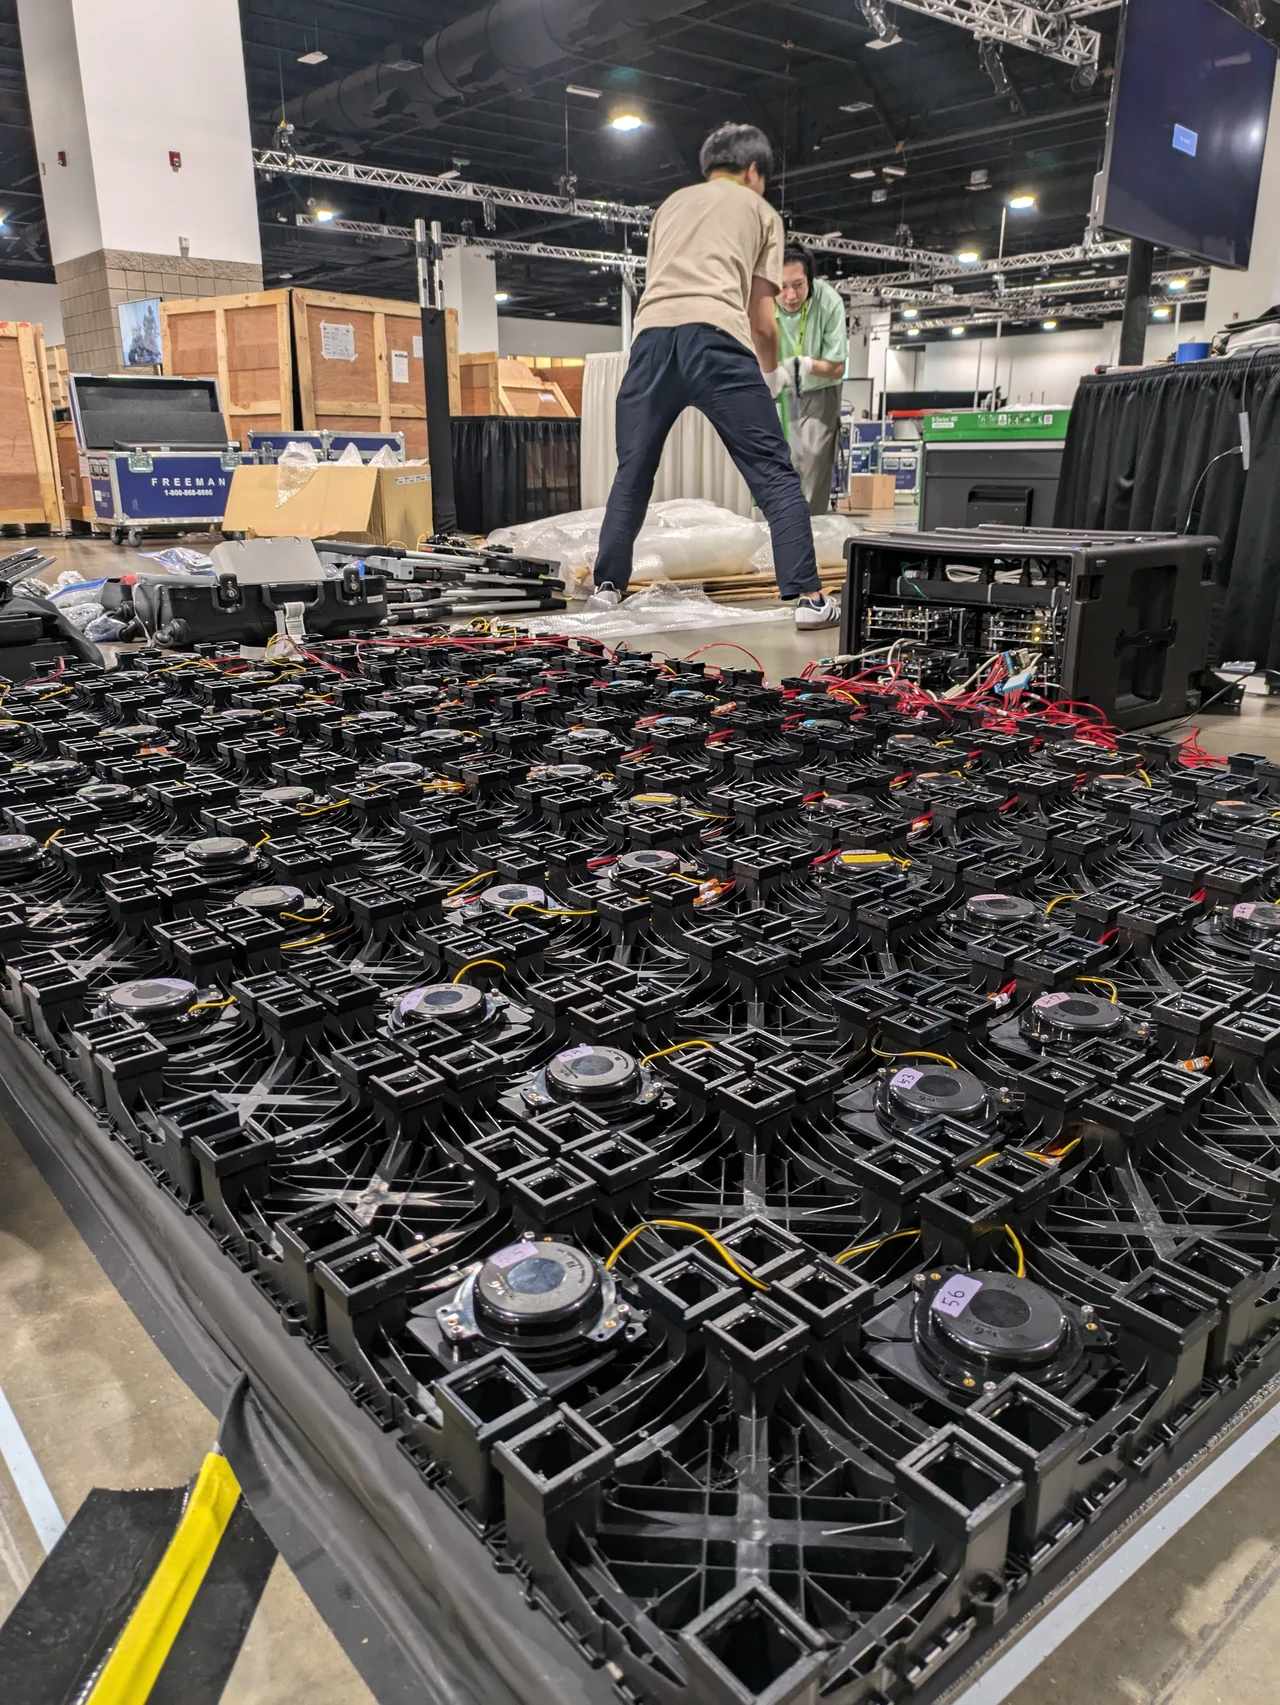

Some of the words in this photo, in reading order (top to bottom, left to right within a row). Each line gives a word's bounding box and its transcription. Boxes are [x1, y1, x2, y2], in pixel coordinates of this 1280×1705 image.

[151, 477, 226, 487] FREEMAN
[561, 1049, 584, 1058] 54
[898, 1072, 916, 1085] 53
[940, 1289, 966, 1308] 56
